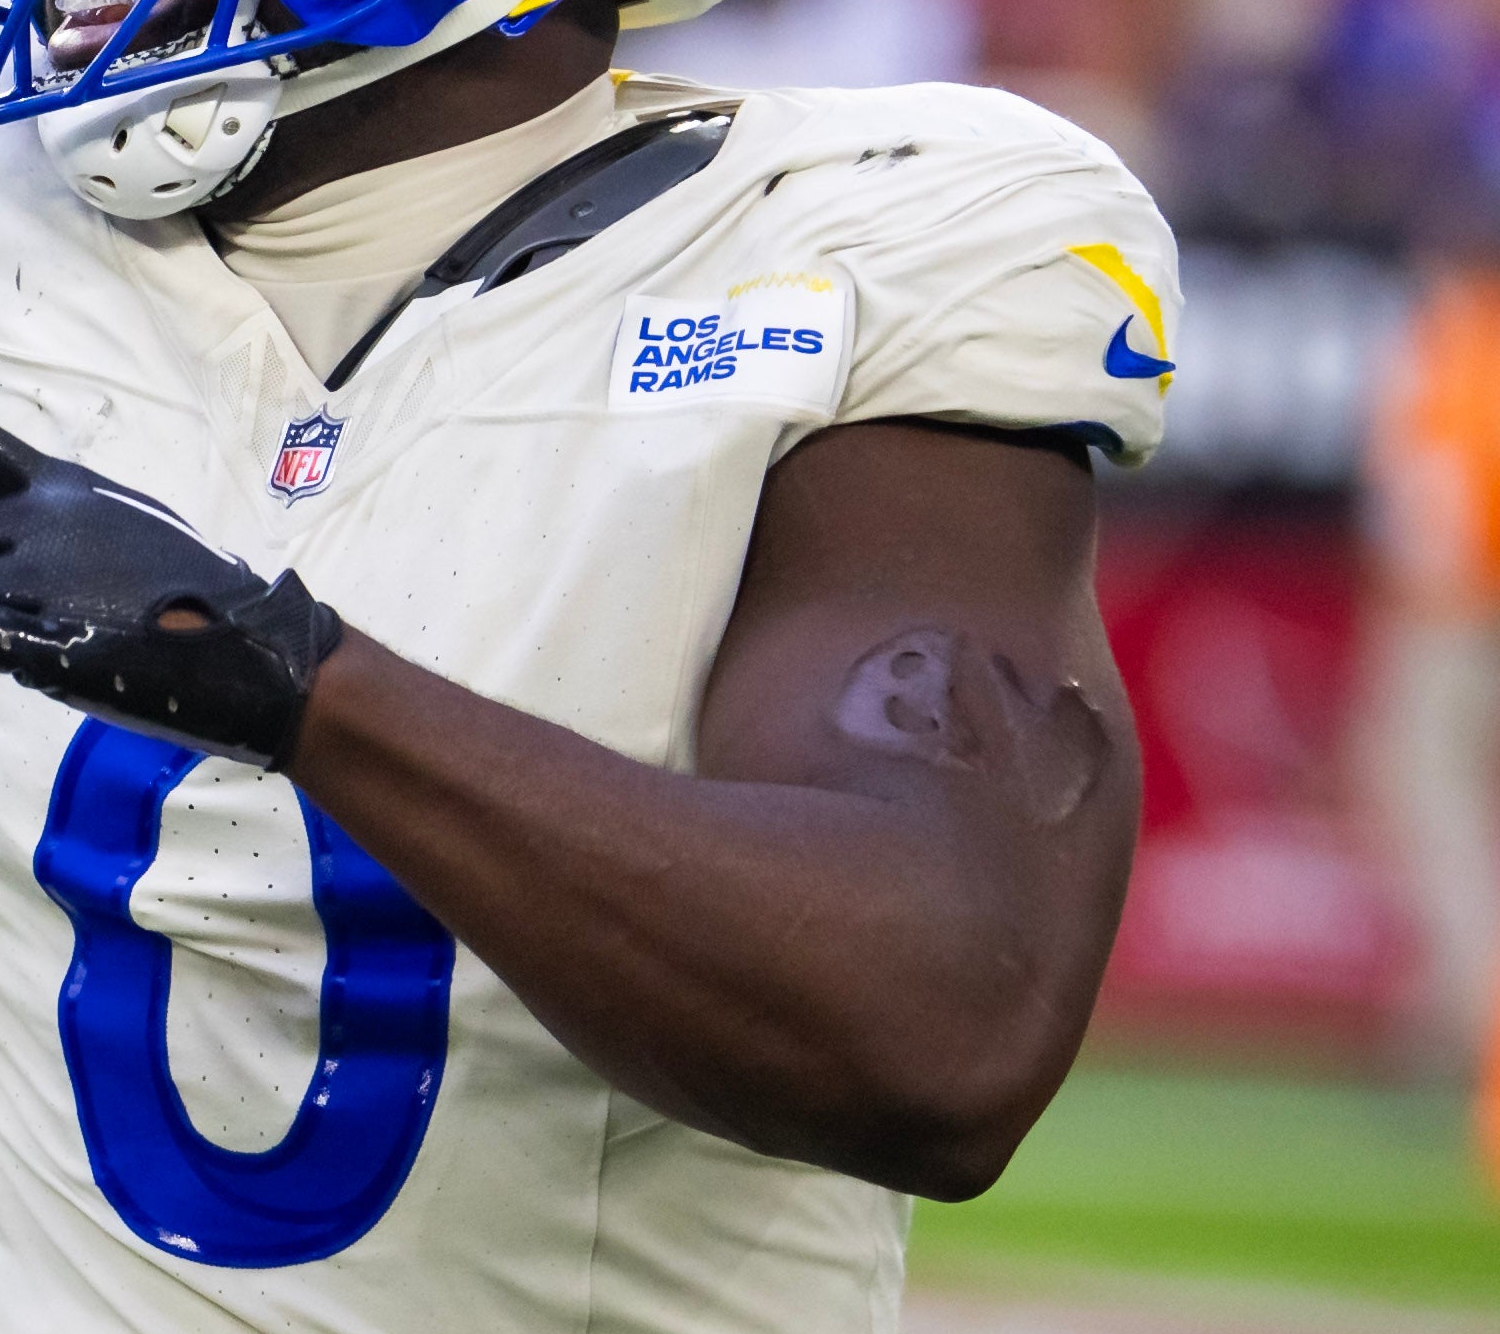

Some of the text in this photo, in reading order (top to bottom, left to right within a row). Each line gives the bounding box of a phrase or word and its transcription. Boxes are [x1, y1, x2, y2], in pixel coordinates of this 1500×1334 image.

[631, 327, 825, 368] ANGELES
[638, 314, 721, 342] LOS
[628, 355, 739, 394] RAMS
[275, 449, 323, 487] NFL
[32, 713, 457, 1270] 0
